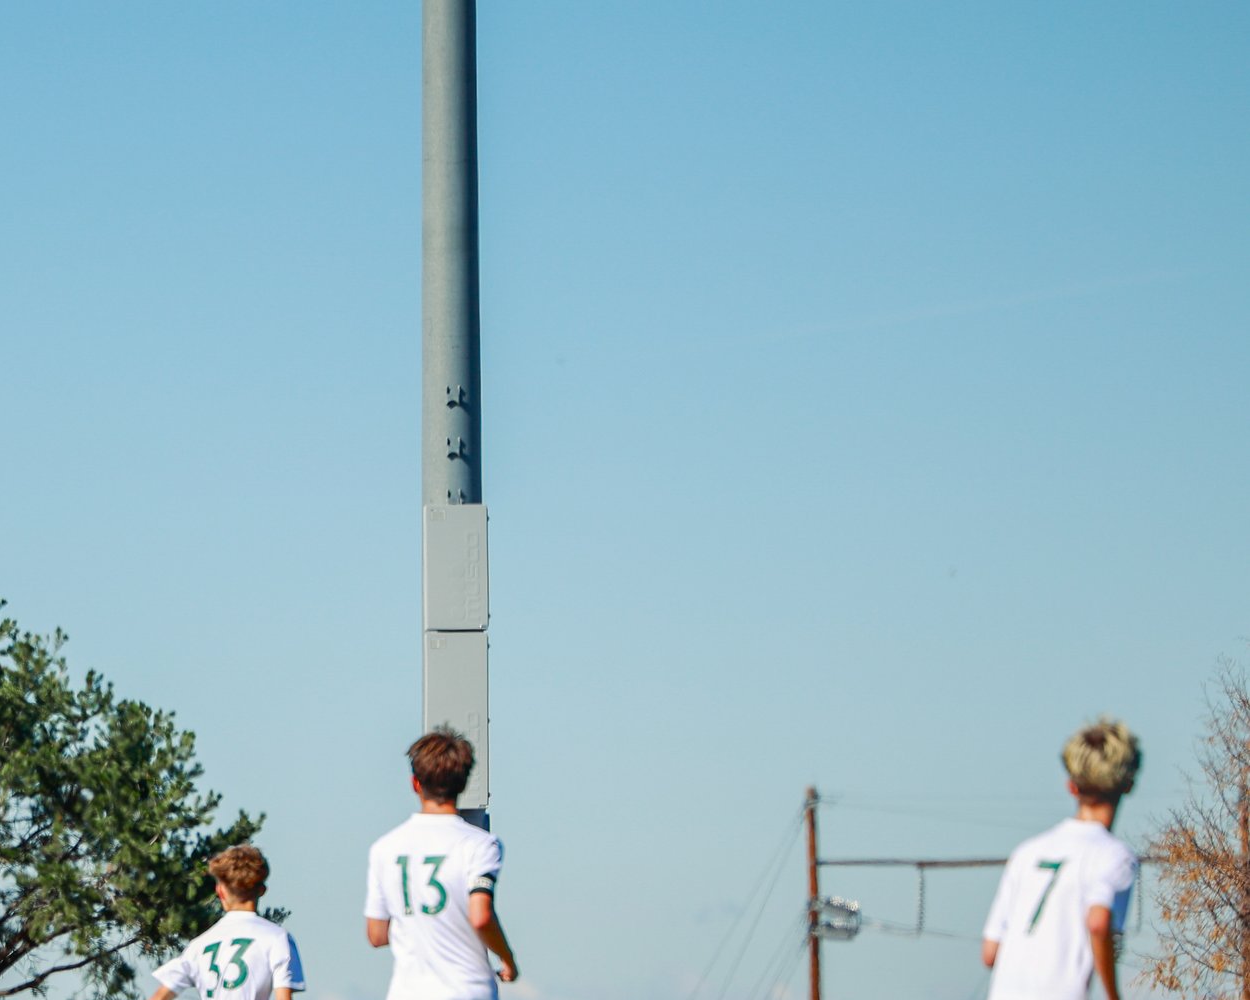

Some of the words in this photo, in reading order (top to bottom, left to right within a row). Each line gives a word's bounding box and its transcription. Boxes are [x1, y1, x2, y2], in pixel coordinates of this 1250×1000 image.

[395, 855, 447, 915] 13
[1026, 860, 1063, 934] 7
[203, 937, 254, 998] 33
